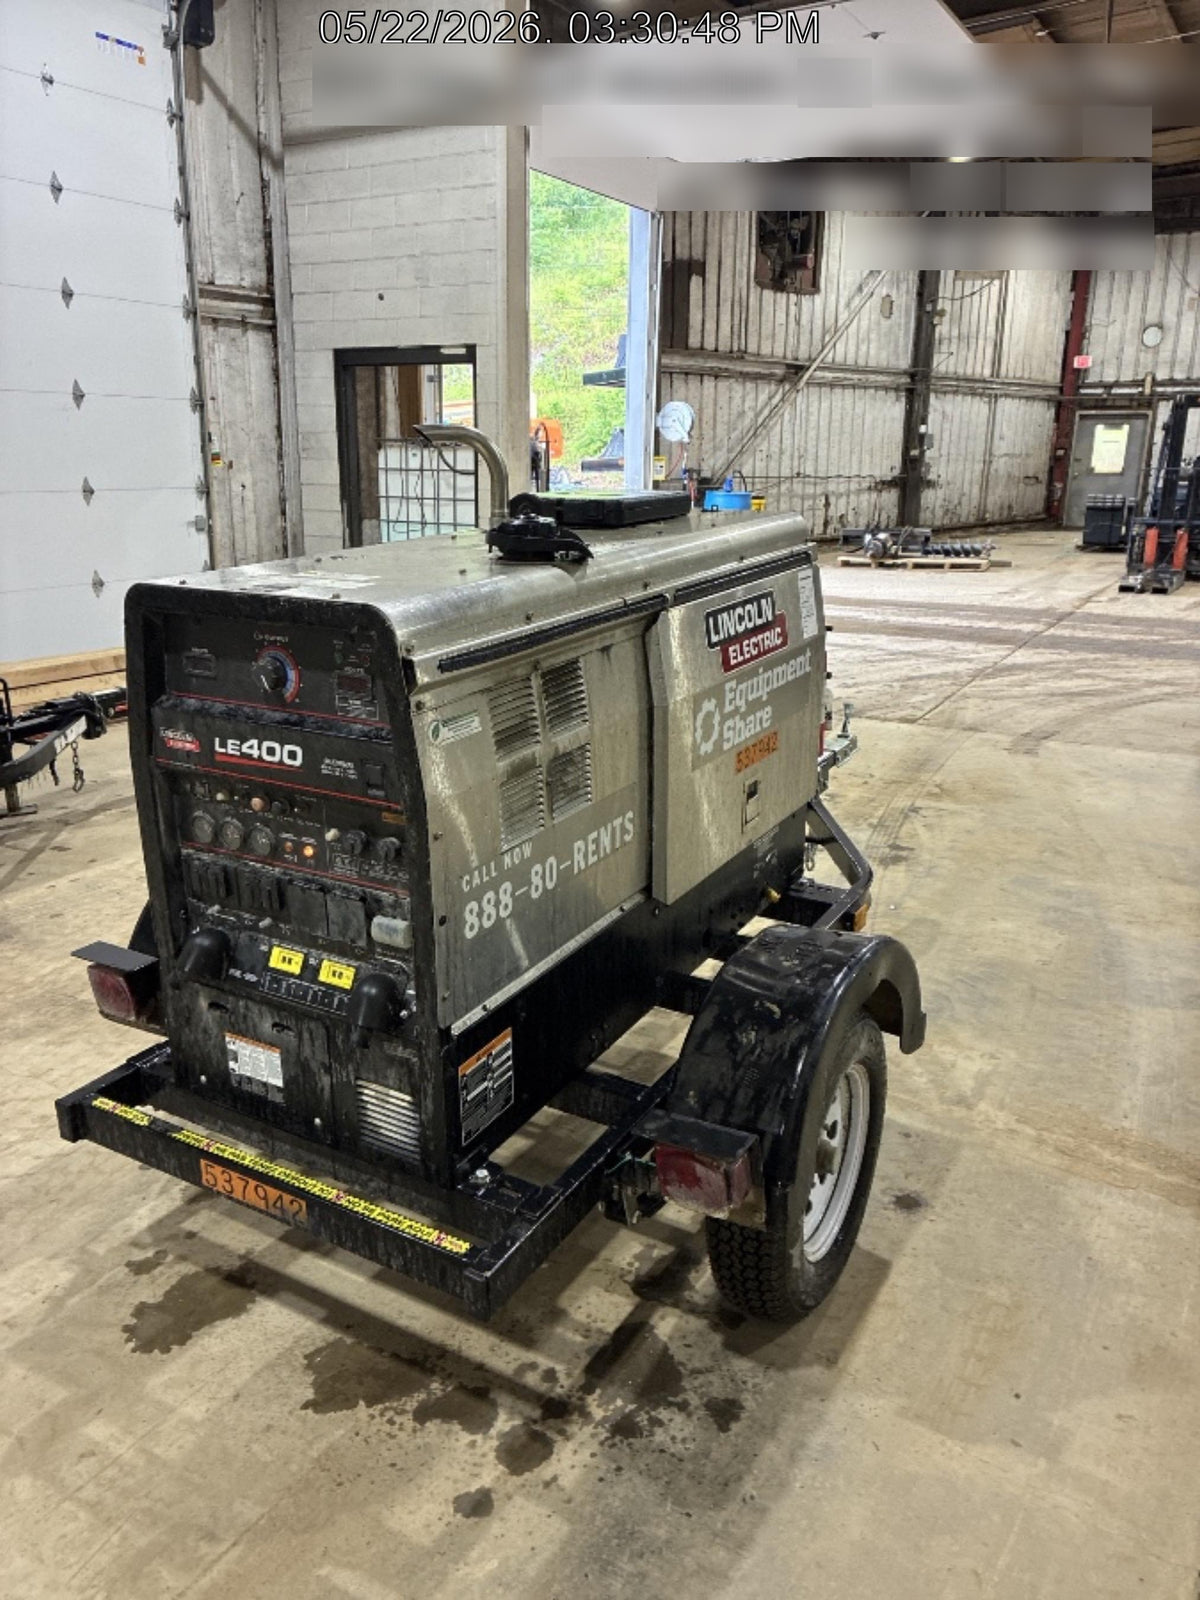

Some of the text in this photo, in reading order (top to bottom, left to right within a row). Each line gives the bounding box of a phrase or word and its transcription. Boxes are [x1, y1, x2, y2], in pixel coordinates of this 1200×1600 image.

[708, 597, 773, 644] LINCOLN
[728, 626, 783, 666] ELECTRIC
[723, 649, 812, 714] Equipment
[214, 737, 303, 767] LE400
[722, 704, 773, 752] Share
[461, 841, 533, 893] CALL NOW
[464, 811, 635, 940] 888-80-RENTS
[204, 1162, 304, 1217] 537942
